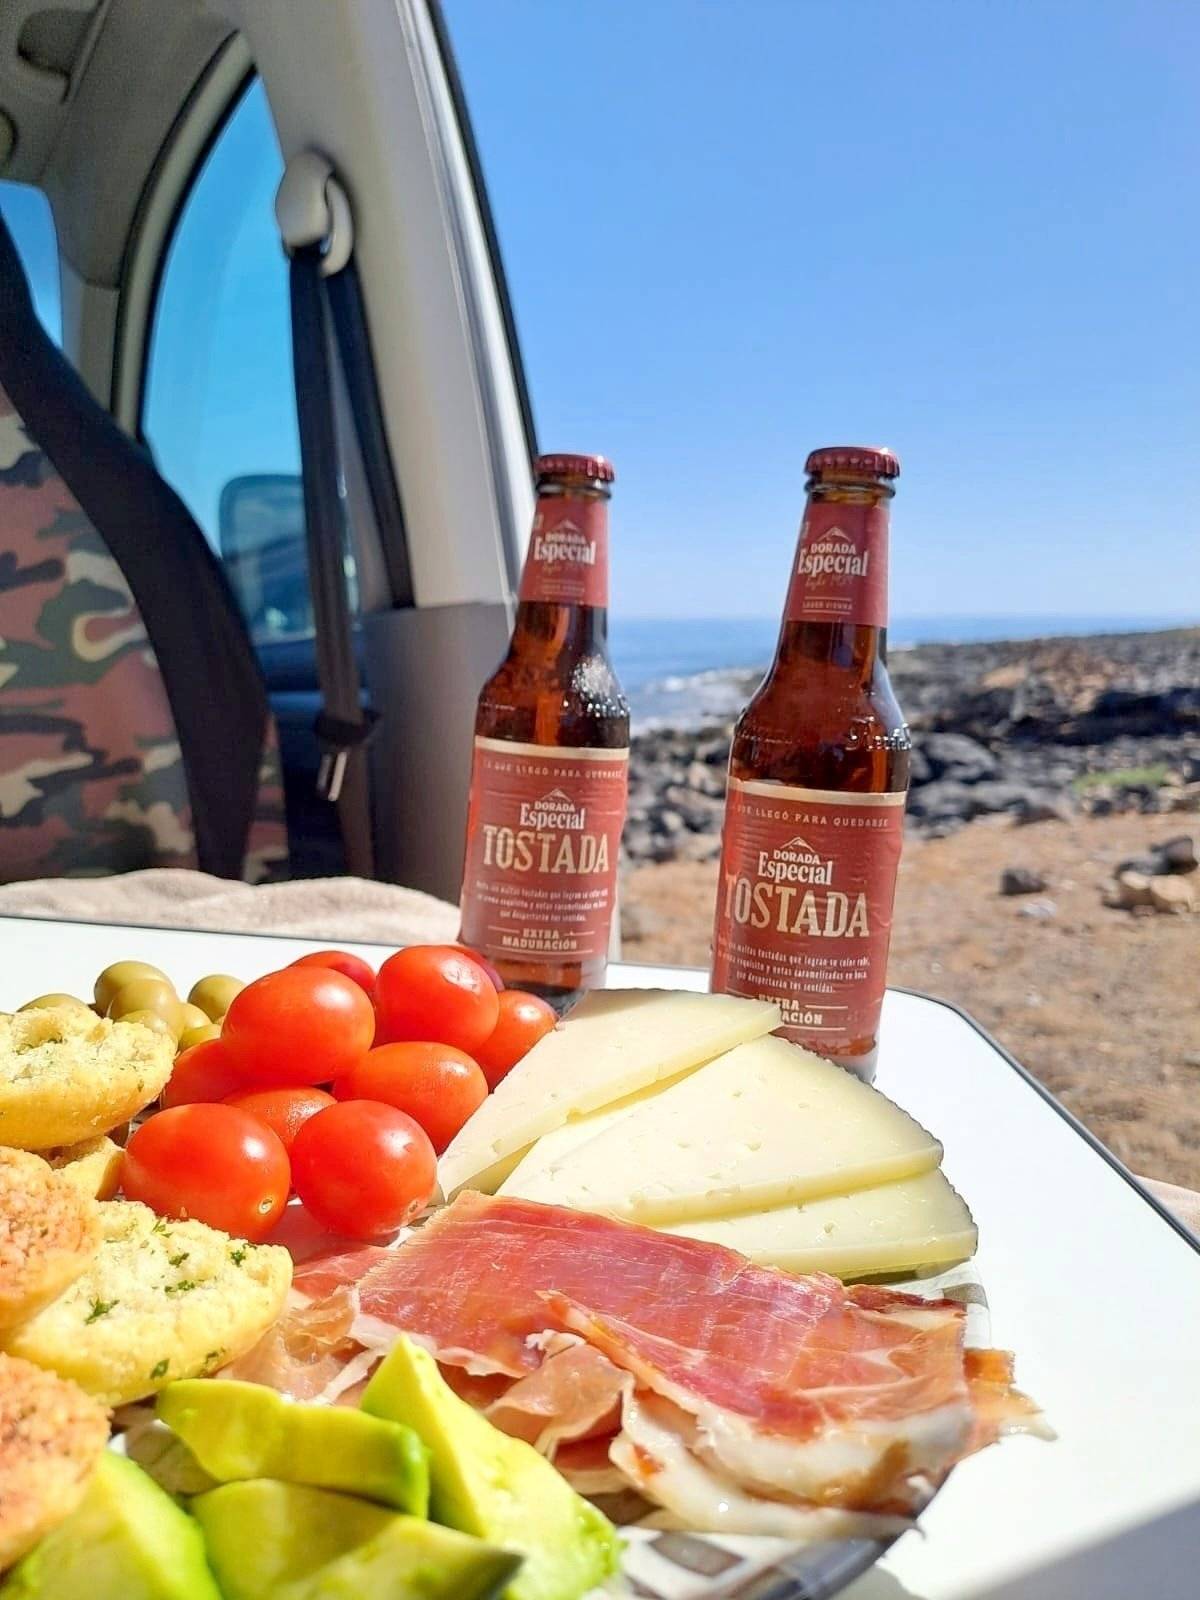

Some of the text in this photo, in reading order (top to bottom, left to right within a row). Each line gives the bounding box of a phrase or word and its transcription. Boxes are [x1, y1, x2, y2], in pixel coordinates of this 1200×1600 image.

[533, 536, 597, 566] Especial
[810, 543, 857, 555] DORADA
[797, 548, 869, 578] Especial
[534, 801, 576, 813] DORADA
[519, 802, 586, 831] Especial
[795, 813, 827, 825] PARA
[483, 824, 609, 874] TOSTADA
[773, 849, 820, 865] DORADA
[757, 851, 833, 886] Especial
[724, 872, 870, 938] TOSTADA
[522, 928, 560, 939] EXTRA
[502, 935, 577, 950] MADURACIÓN
[782, 1010, 823, 1025] ACIÓN
